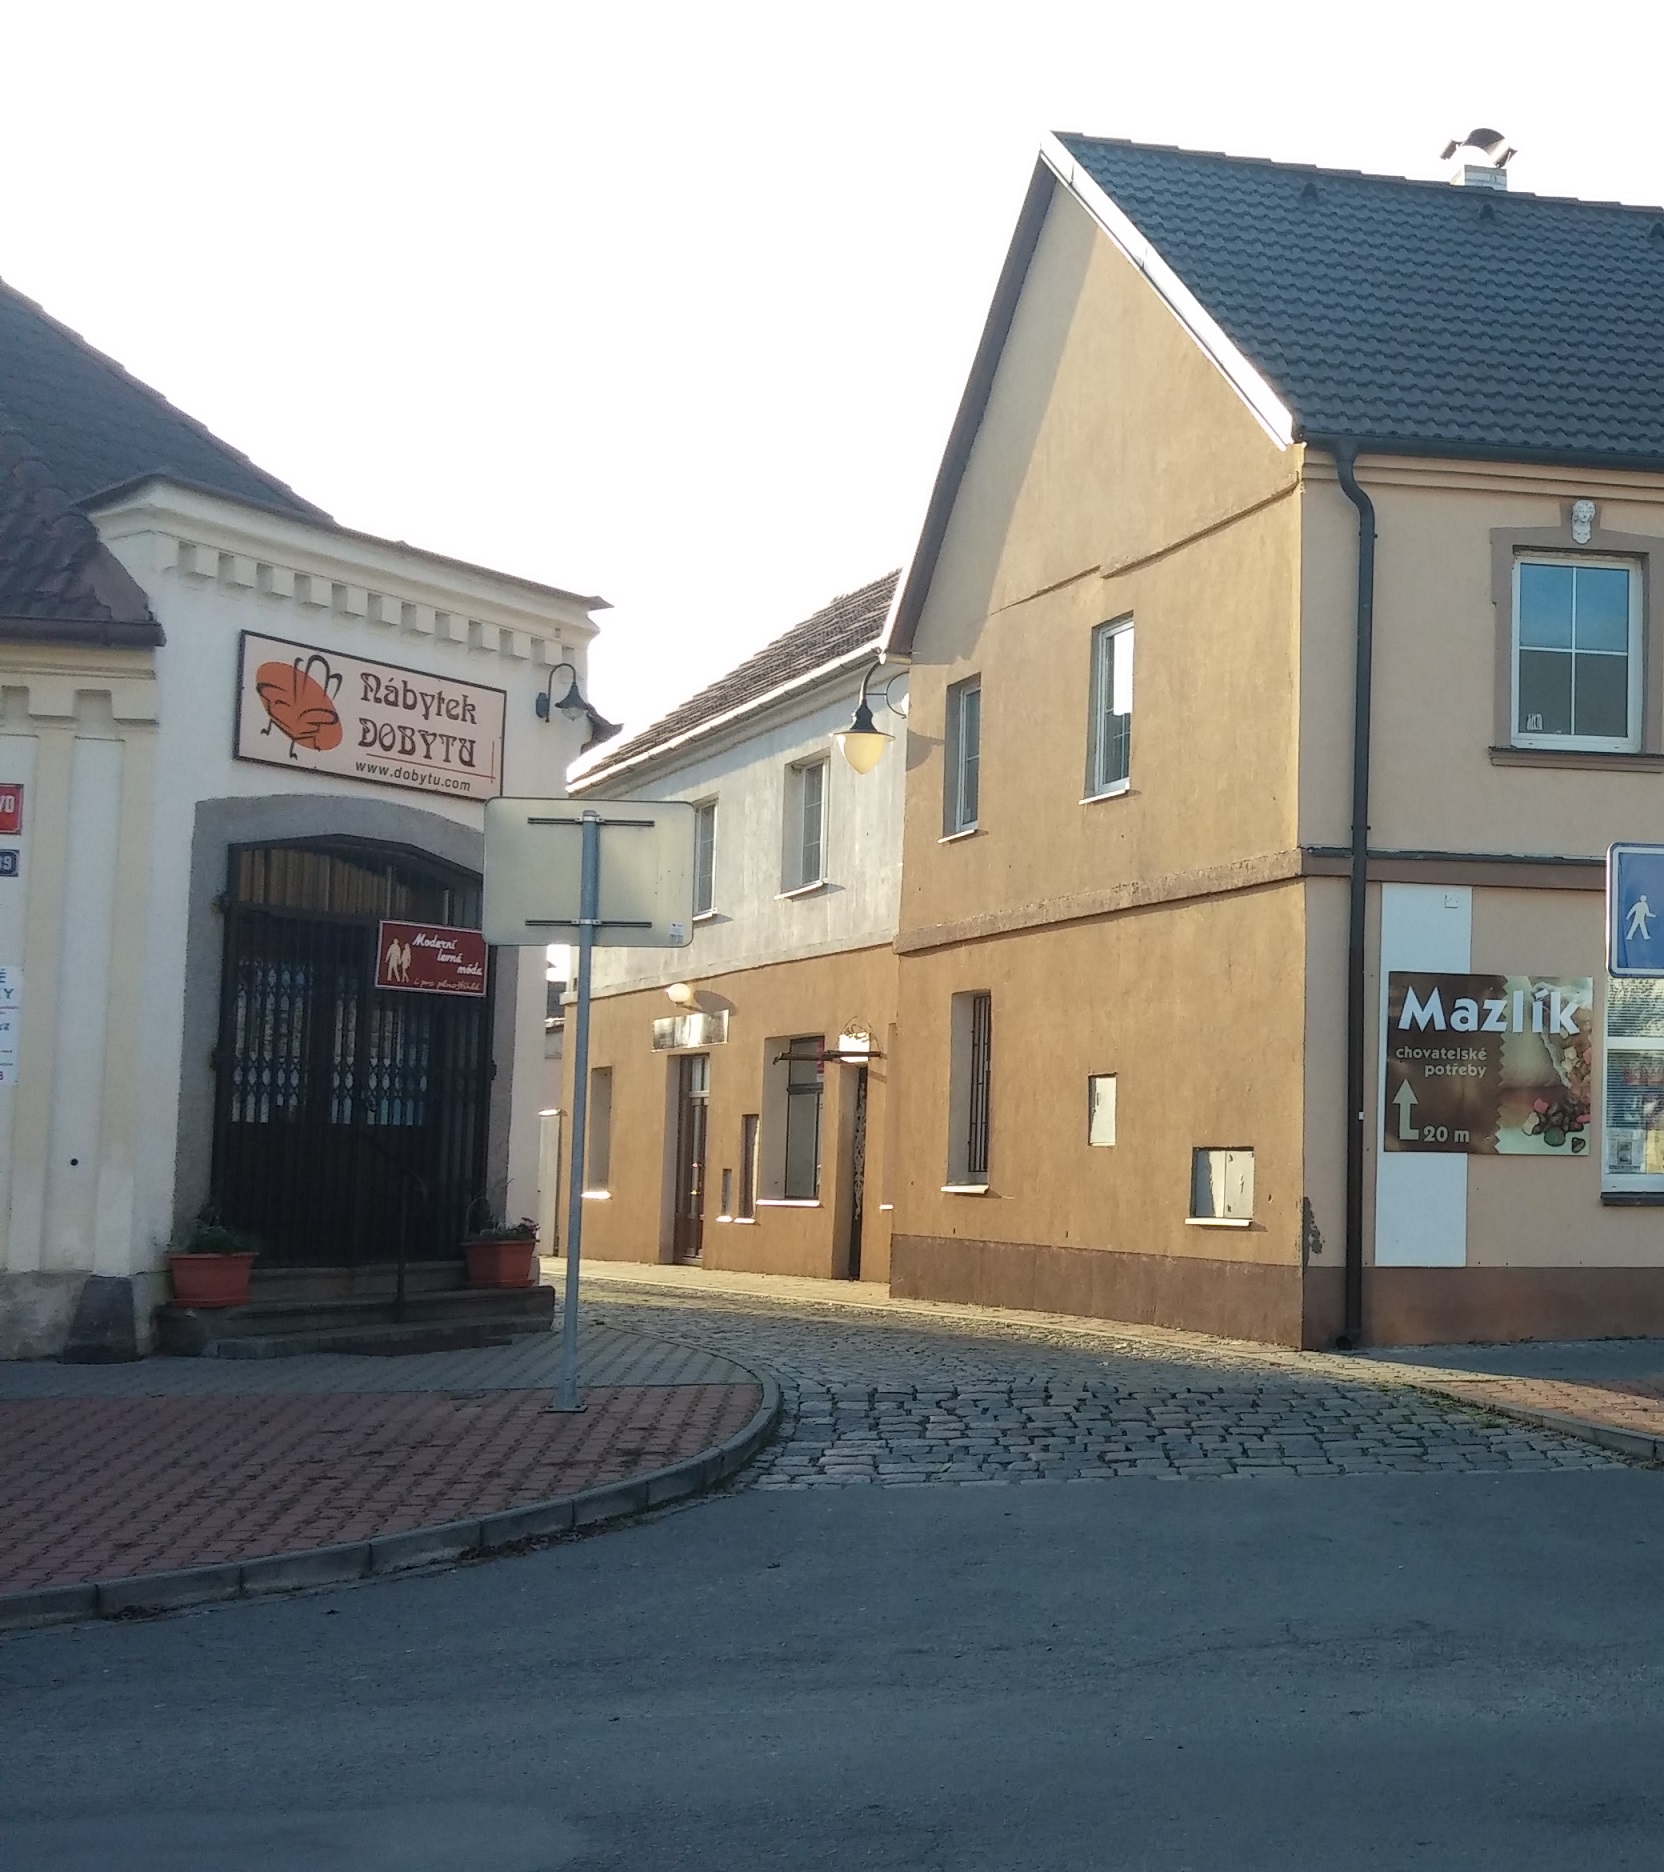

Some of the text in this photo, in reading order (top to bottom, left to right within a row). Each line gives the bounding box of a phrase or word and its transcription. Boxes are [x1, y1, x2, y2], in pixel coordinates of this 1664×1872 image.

[360, 672, 477, 725] Nábytek
[358, 717, 477, 768] DOBYTU
[355, 760, 471, 792] www.dobytu.com
[412, 933, 458, 950] Moderní
[1397, 984, 1581, 1035] Mazlík
[1395, 1045, 1488, 1061] chovatelské
[1424, 1062, 1488, 1079] potřeby
[1423, 1125, 1471, 1143] 20 m
